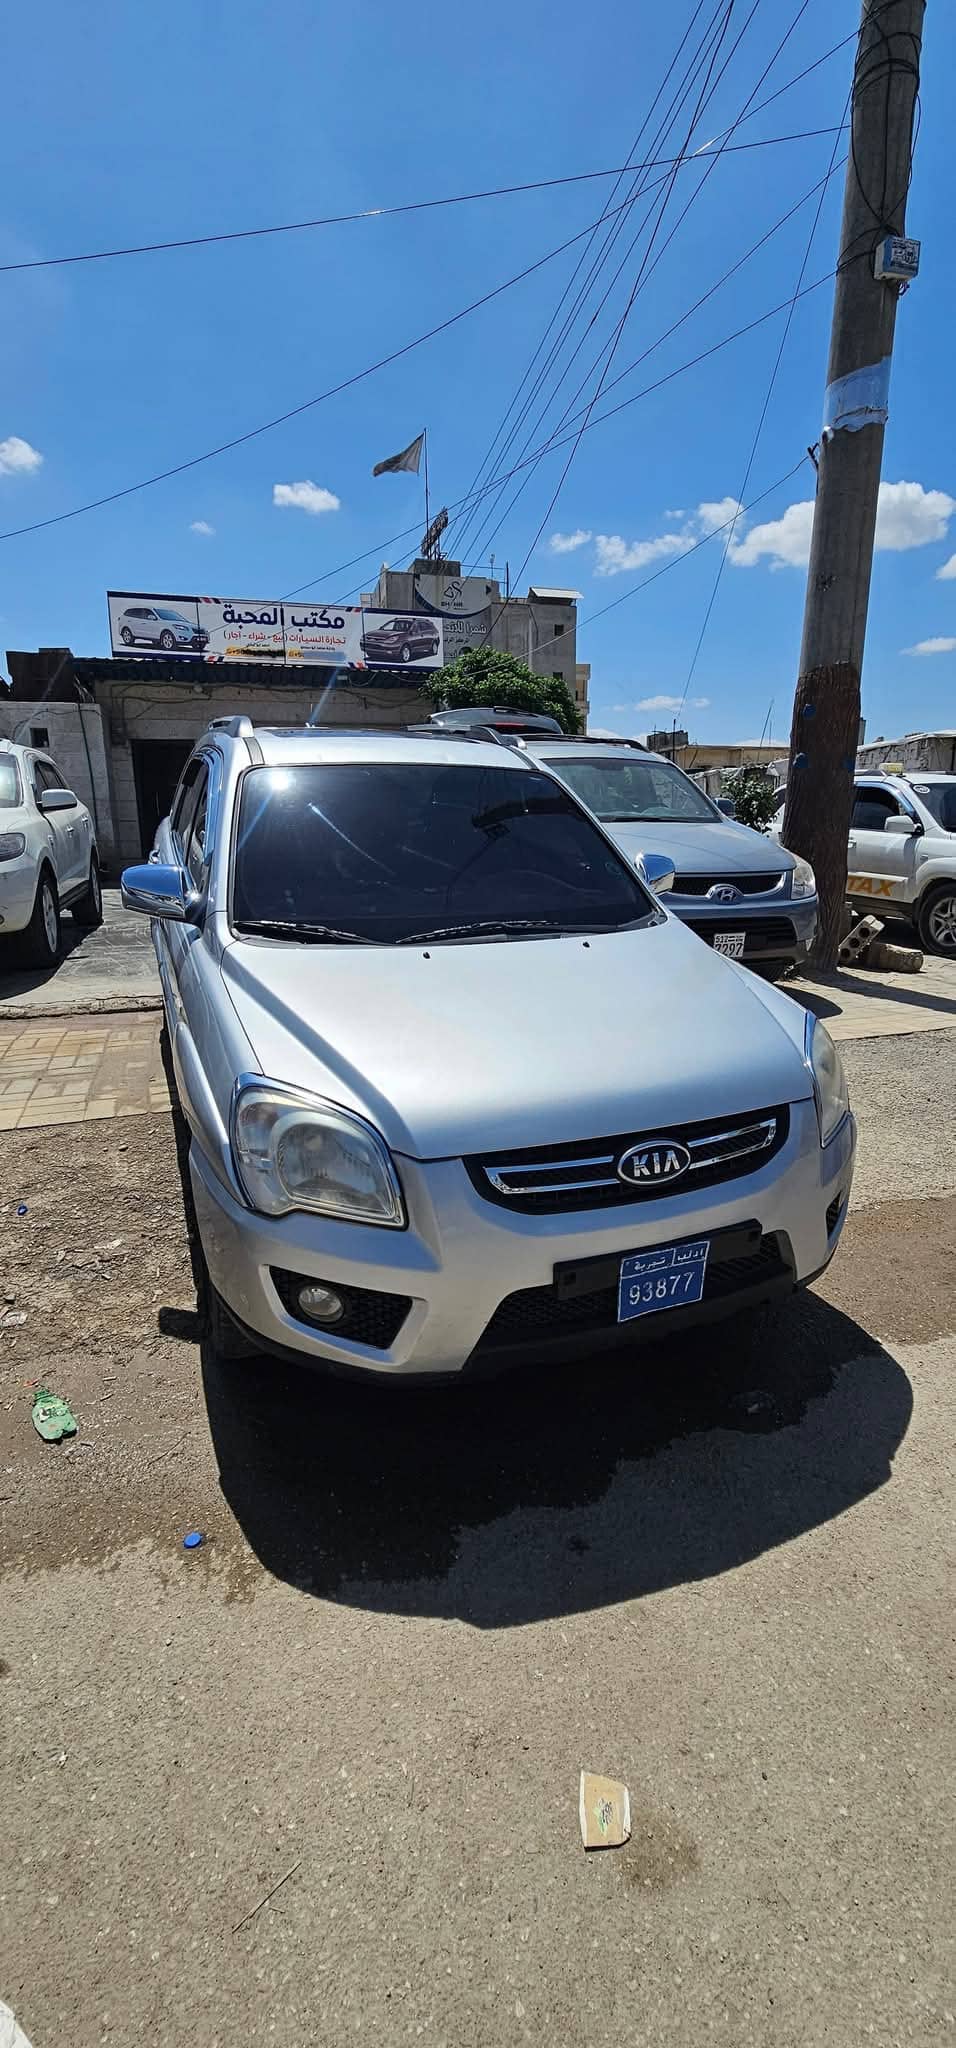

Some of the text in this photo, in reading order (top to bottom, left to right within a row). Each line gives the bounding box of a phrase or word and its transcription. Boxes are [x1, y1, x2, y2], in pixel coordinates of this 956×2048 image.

[222, 604, 345, 632] مكتب المحبة
[288, 633, 324, 644] السيارات
[325, 635, 346, 645] تجارة
[632, 1150, 680, 1177] KIA
[634, 1256, 666, 1271] تجربة
[629, 1271, 695, 1305] 93877
